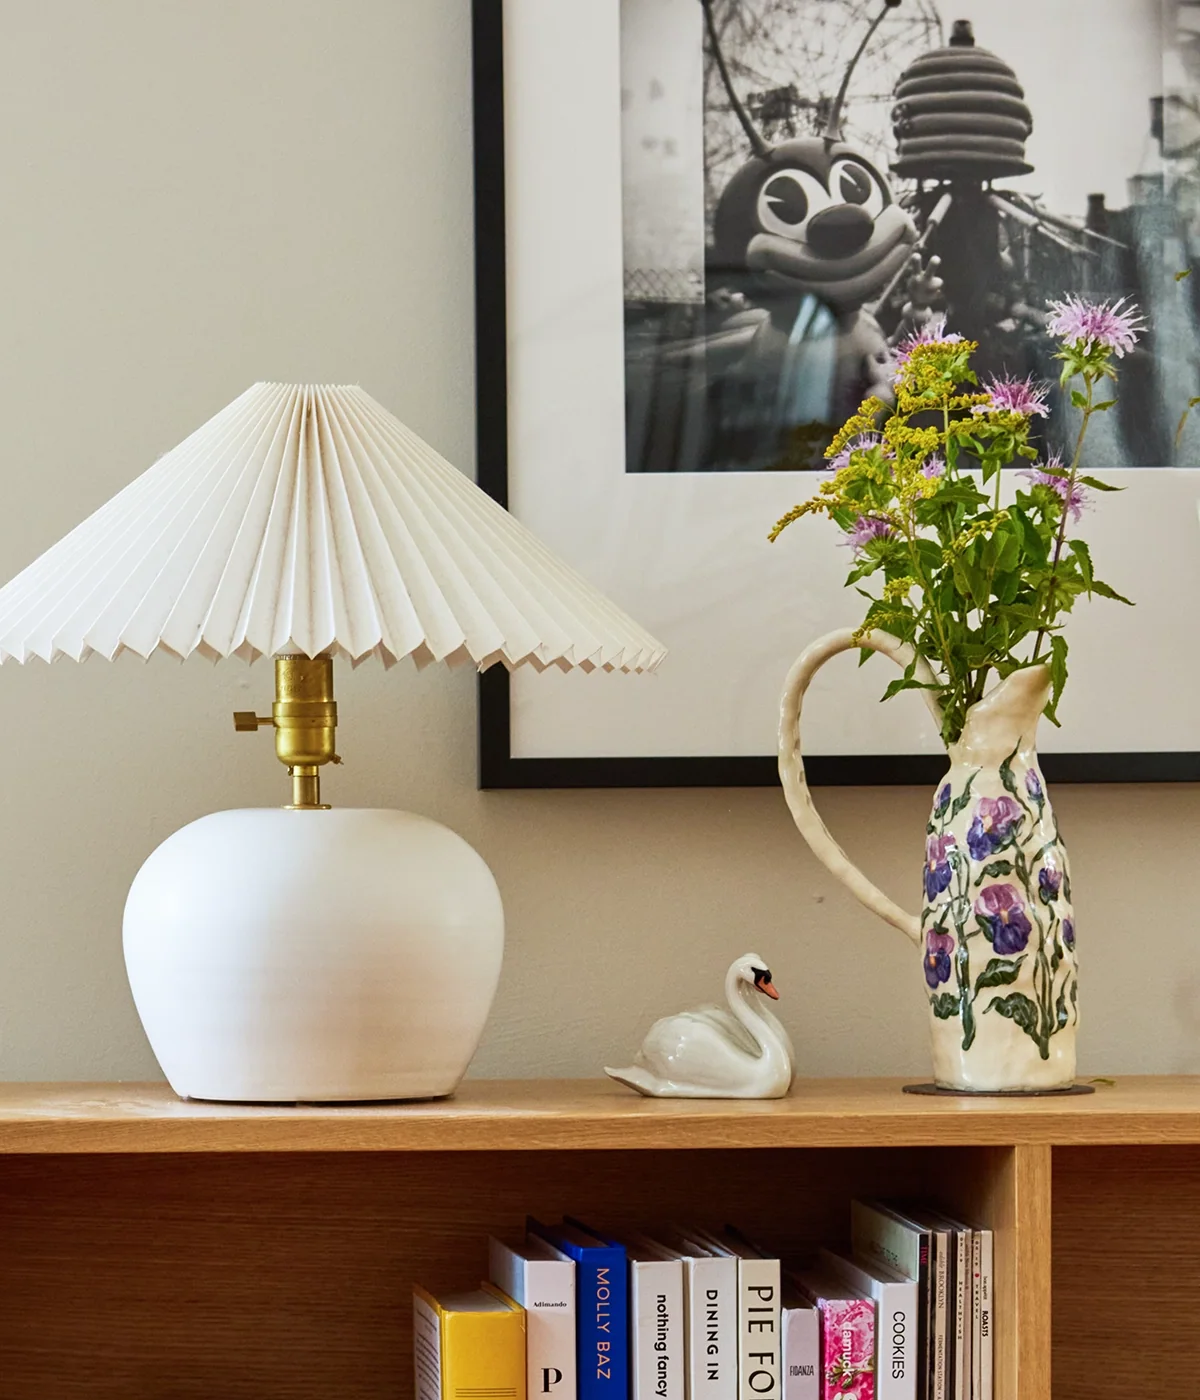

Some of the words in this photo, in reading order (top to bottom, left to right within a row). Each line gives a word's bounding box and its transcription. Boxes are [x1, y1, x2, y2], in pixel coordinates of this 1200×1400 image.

[596, 1268, 610, 1334] MOLLY
[654, 1294, 669, 1352] nothing
[706, 1289, 719, 1355] DINING
[747, 1286, 774, 1333] PIE
[981, 1310, 989, 1337] ROASTS
[596, 1341, 611, 1380] BAZ
[842, 1320, 854, 1377] damuck
[892, 1311, 906, 1380] COOKIES
[655, 1355, 670, 1398] fancy
[707, 1362, 719, 1381] IN
[789, 1365, 815, 1376] FIDANZA
